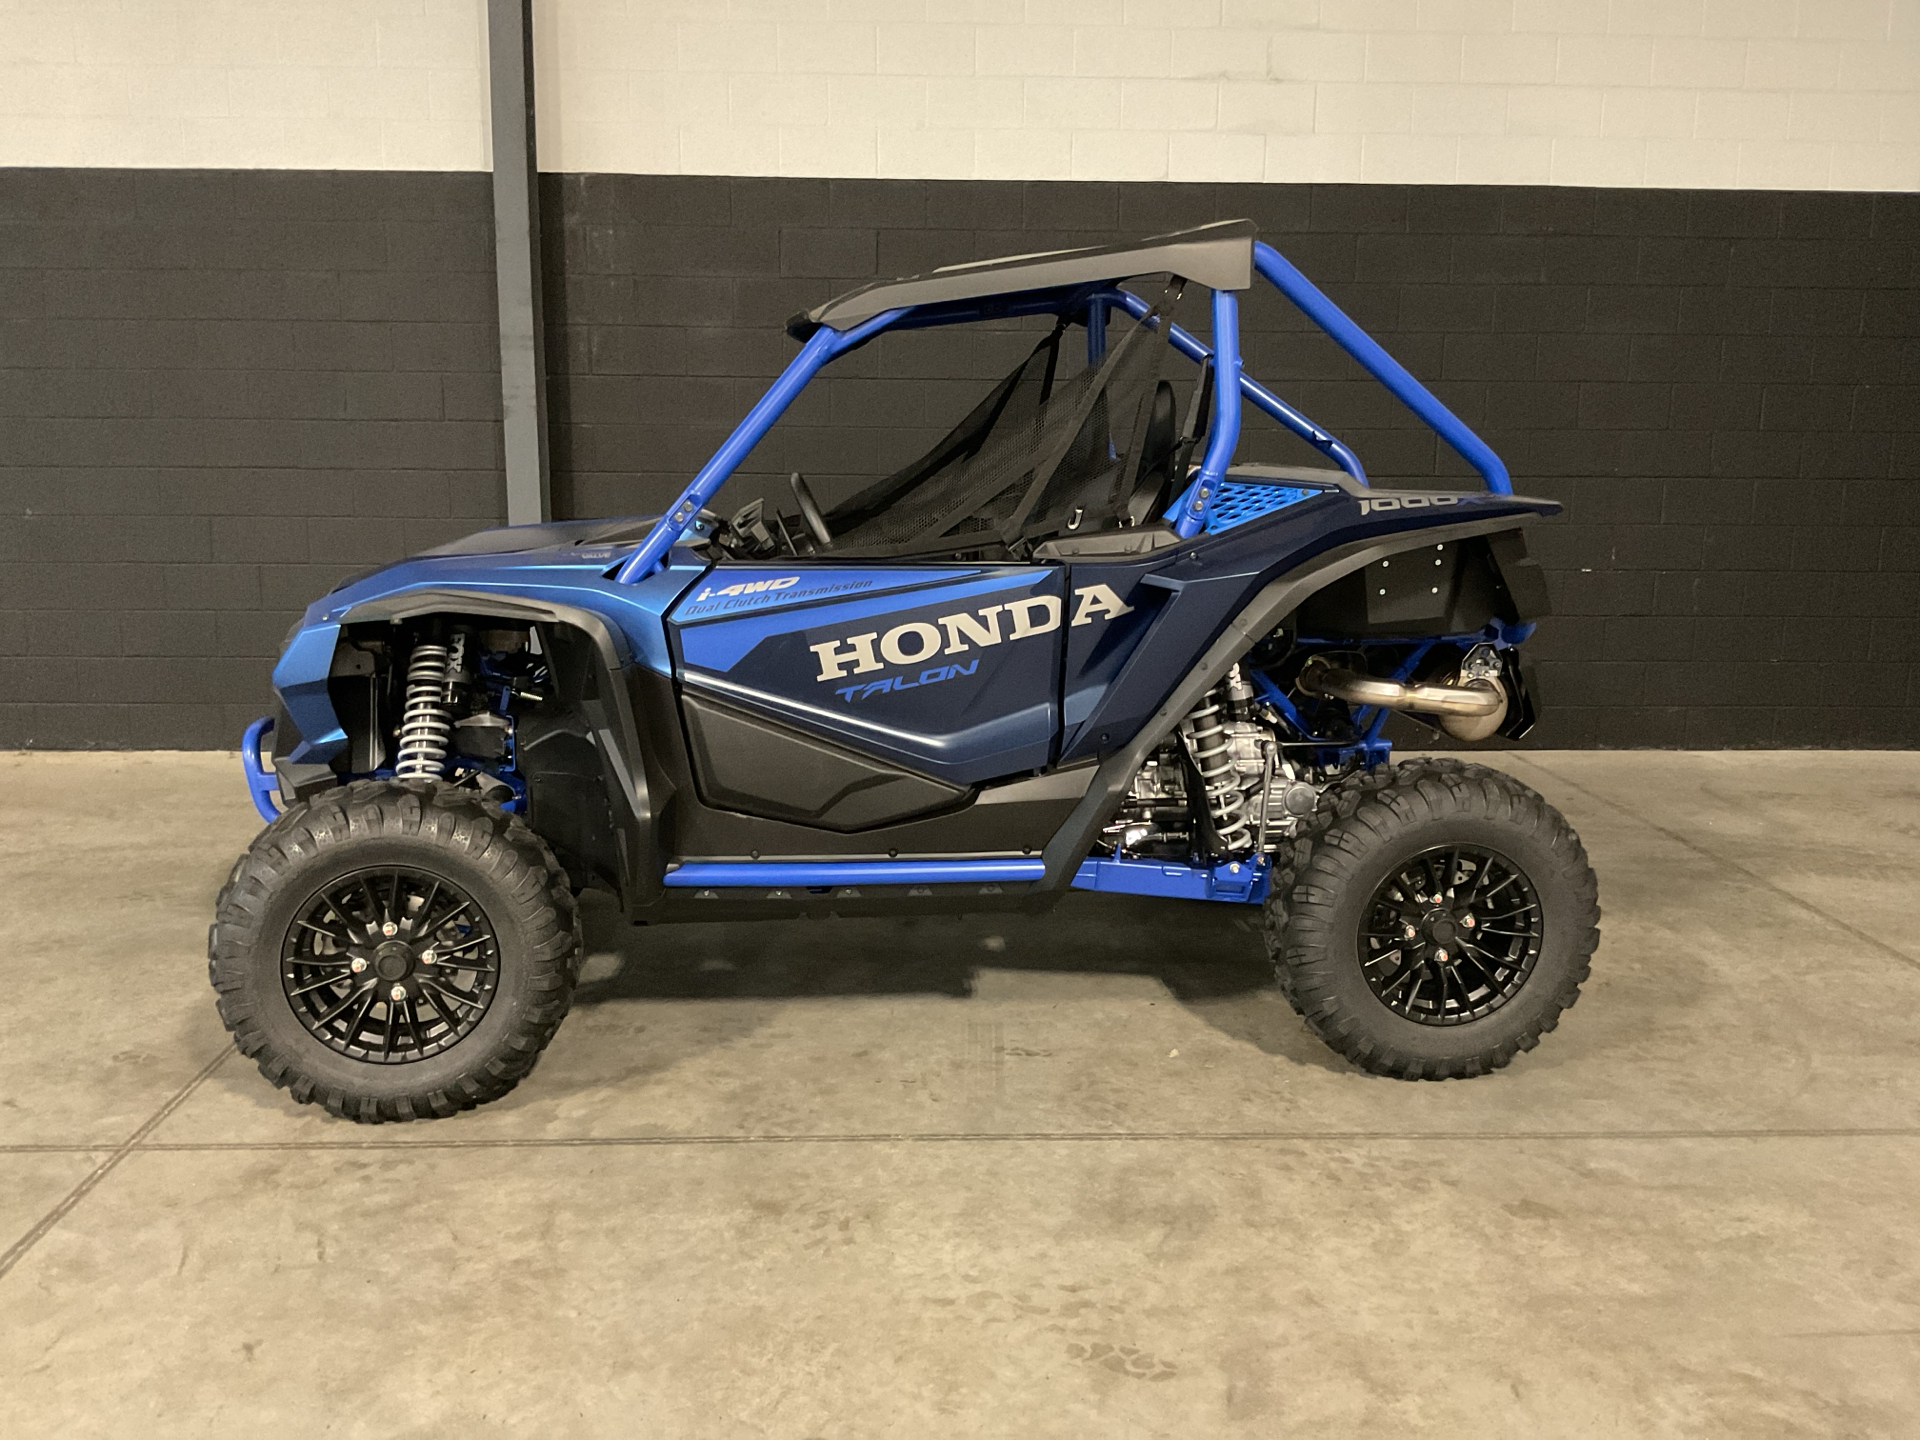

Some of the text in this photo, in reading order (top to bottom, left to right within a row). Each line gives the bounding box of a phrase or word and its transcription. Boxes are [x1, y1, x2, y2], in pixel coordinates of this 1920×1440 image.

[685, 579, 873, 616] Dual Clutch Transmission
[696, 576, 800, 602] i-4WD
[809, 584, 1135, 682] HONDA
[835, 659, 980, 703] TALON
